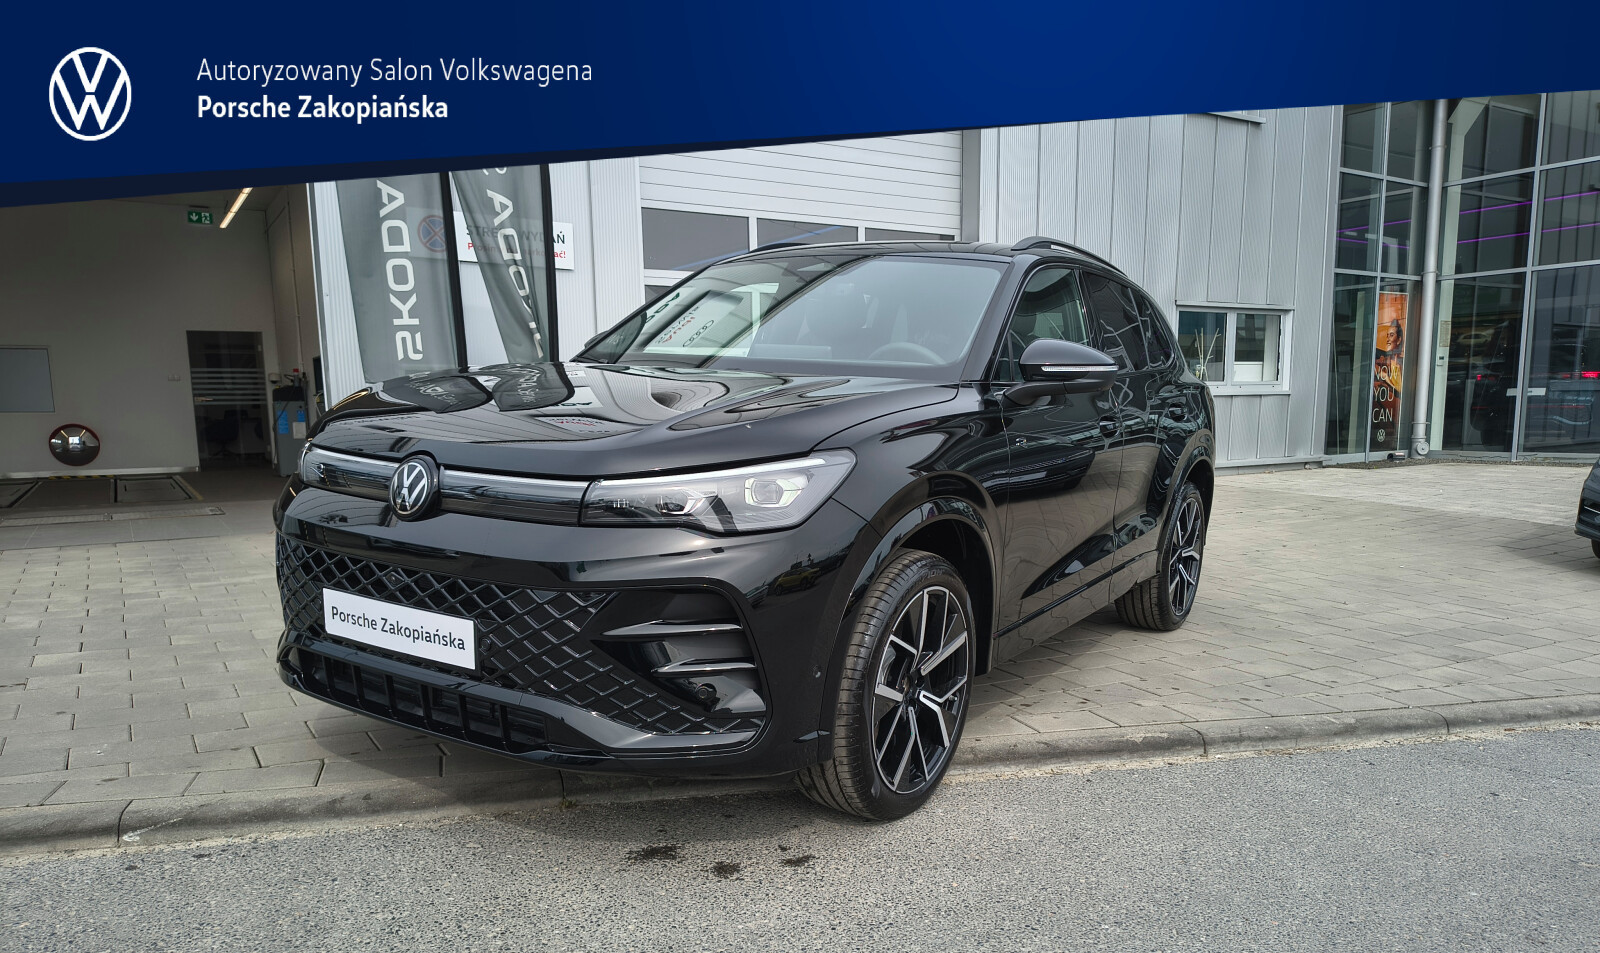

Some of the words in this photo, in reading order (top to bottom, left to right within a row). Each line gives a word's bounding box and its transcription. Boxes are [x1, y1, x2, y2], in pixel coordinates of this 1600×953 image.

[1375, 365, 1399, 380] NOW
[1374, 387, 1395, 402] YOU
[1372, 408, 1393, 423] CAN
[331, 605, 377, 630] Porsche
[380, 617, 466, 650] Zakopiańska
